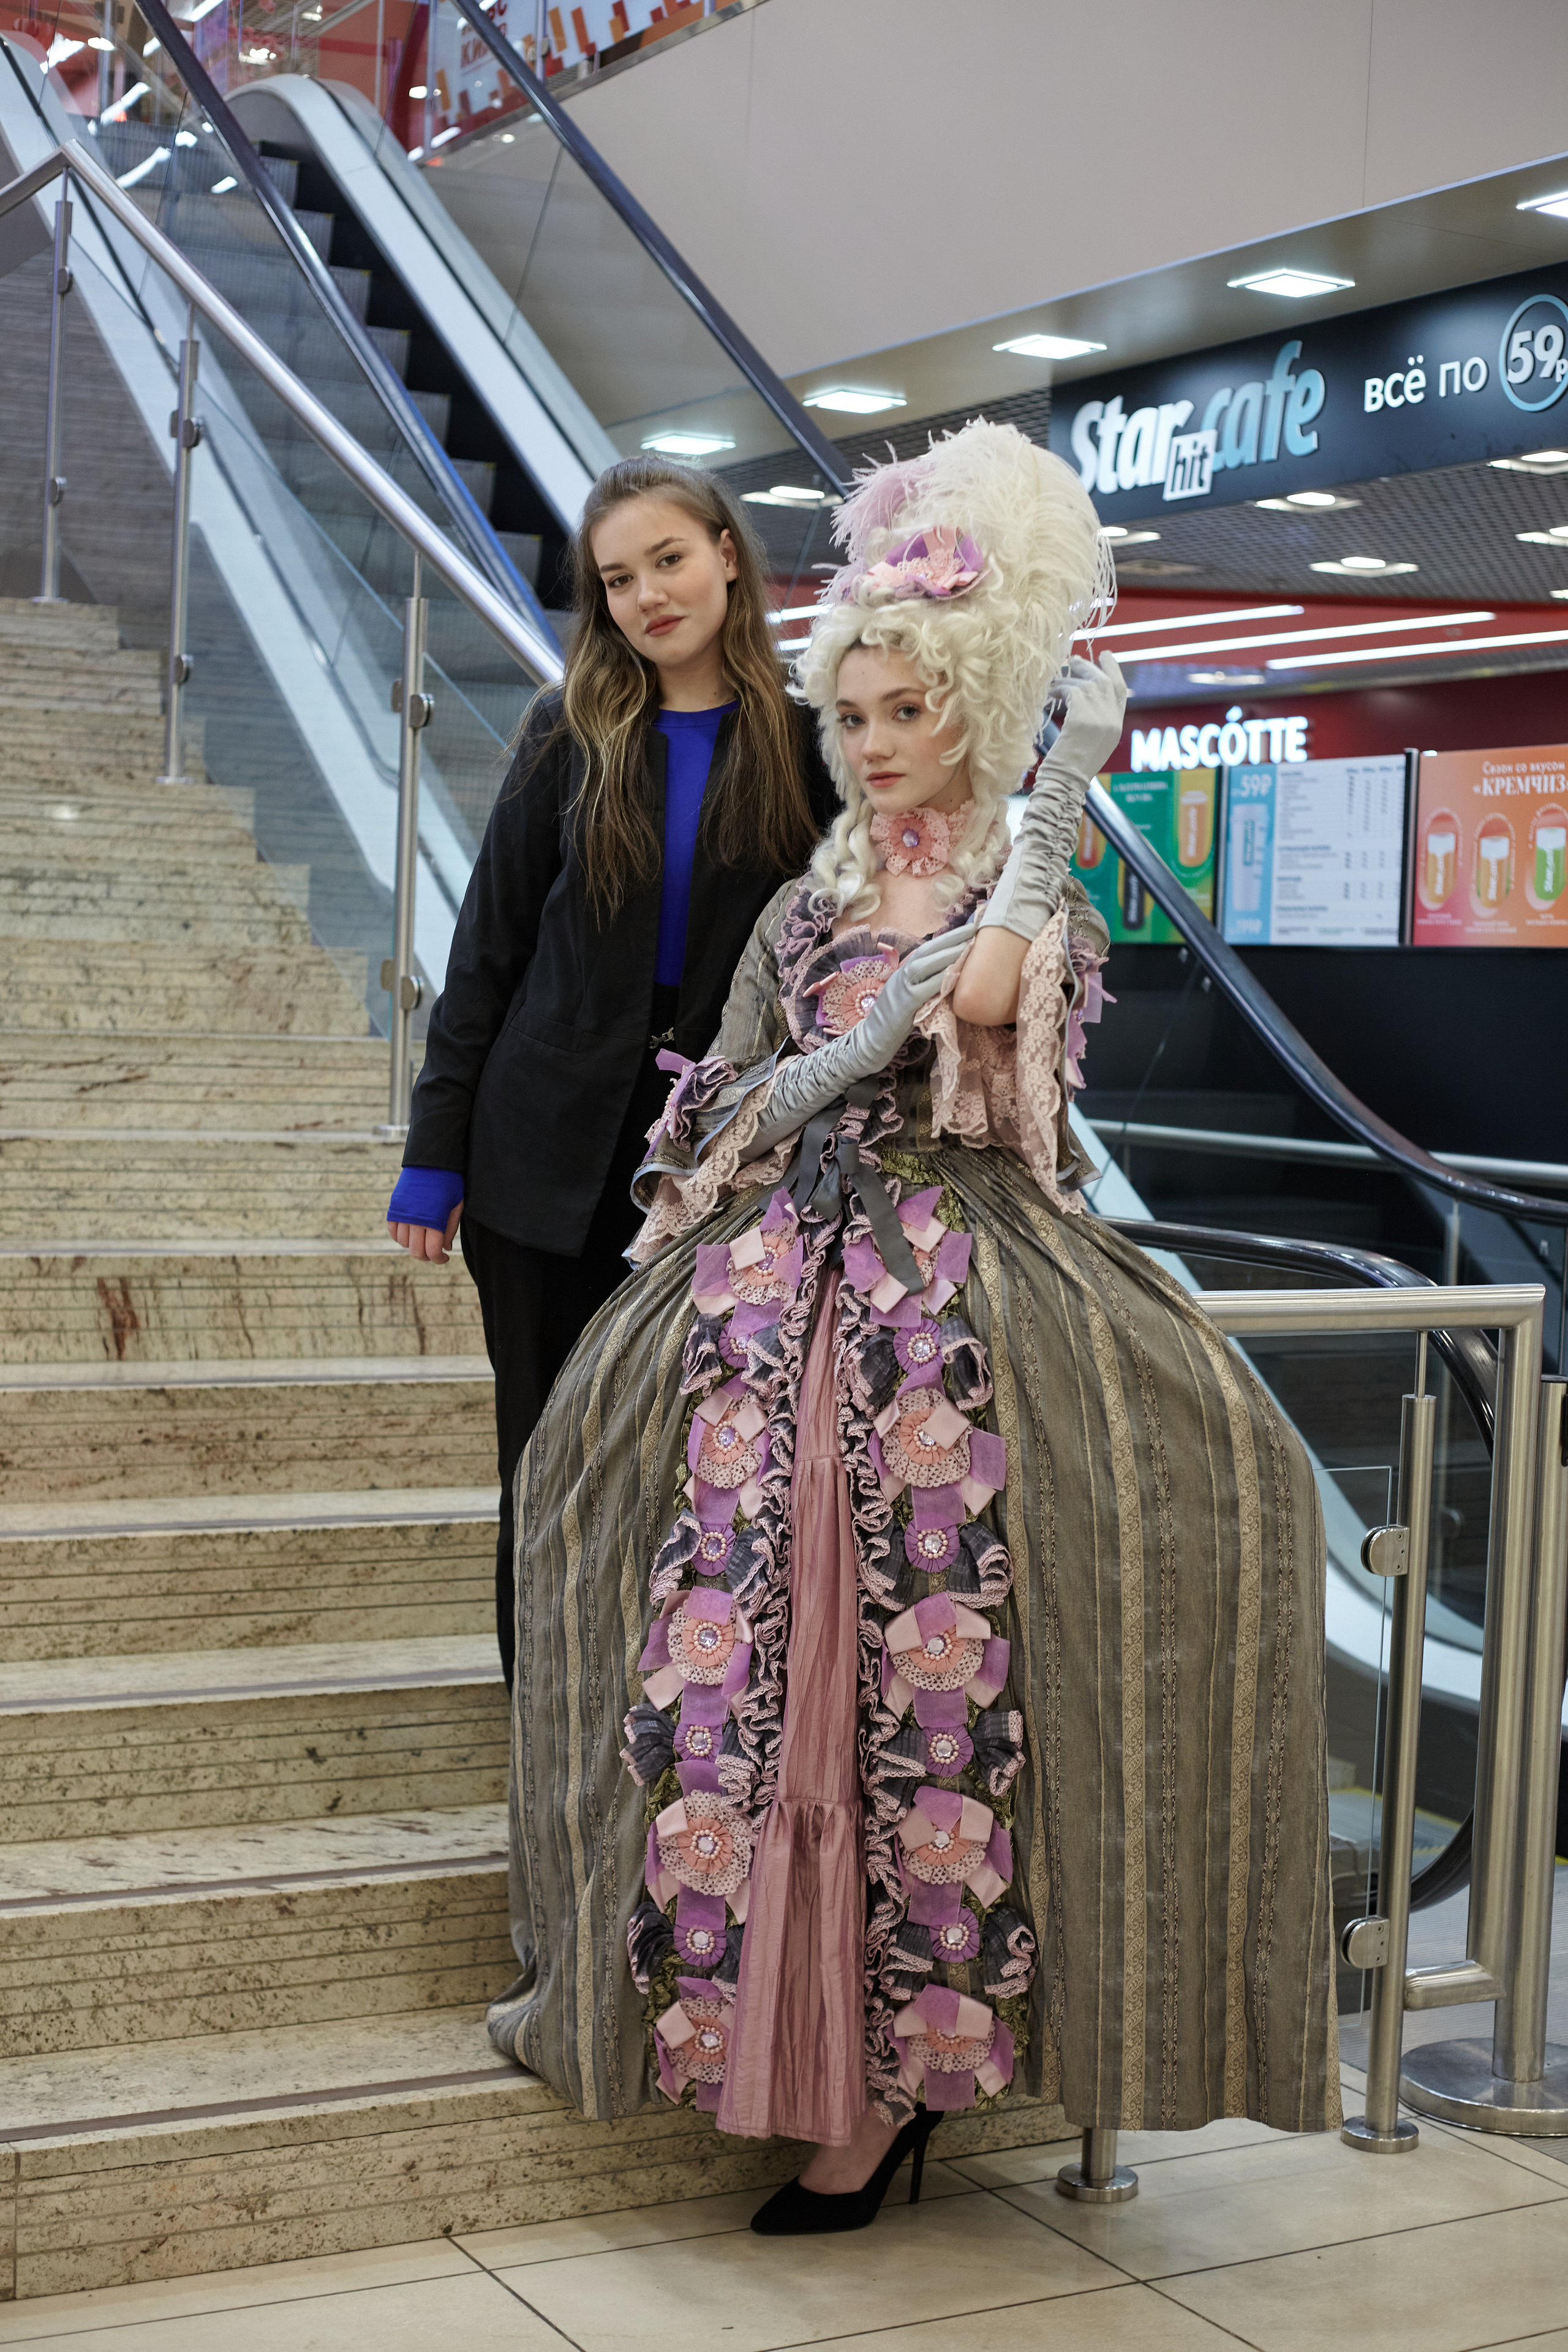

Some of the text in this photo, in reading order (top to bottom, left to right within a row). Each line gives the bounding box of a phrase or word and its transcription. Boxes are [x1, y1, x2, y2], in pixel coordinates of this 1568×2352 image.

[1363, 355, 1427, 413] всё
[1439, 356, 1488, 398] по
[1071, 340, 1325, 494] Star cafe
[1170, 440, 1209, 492] hit
[1131, 706, 1308, 773] MASCÓTTE
[1529, 761, 1566, 774] вкусом
